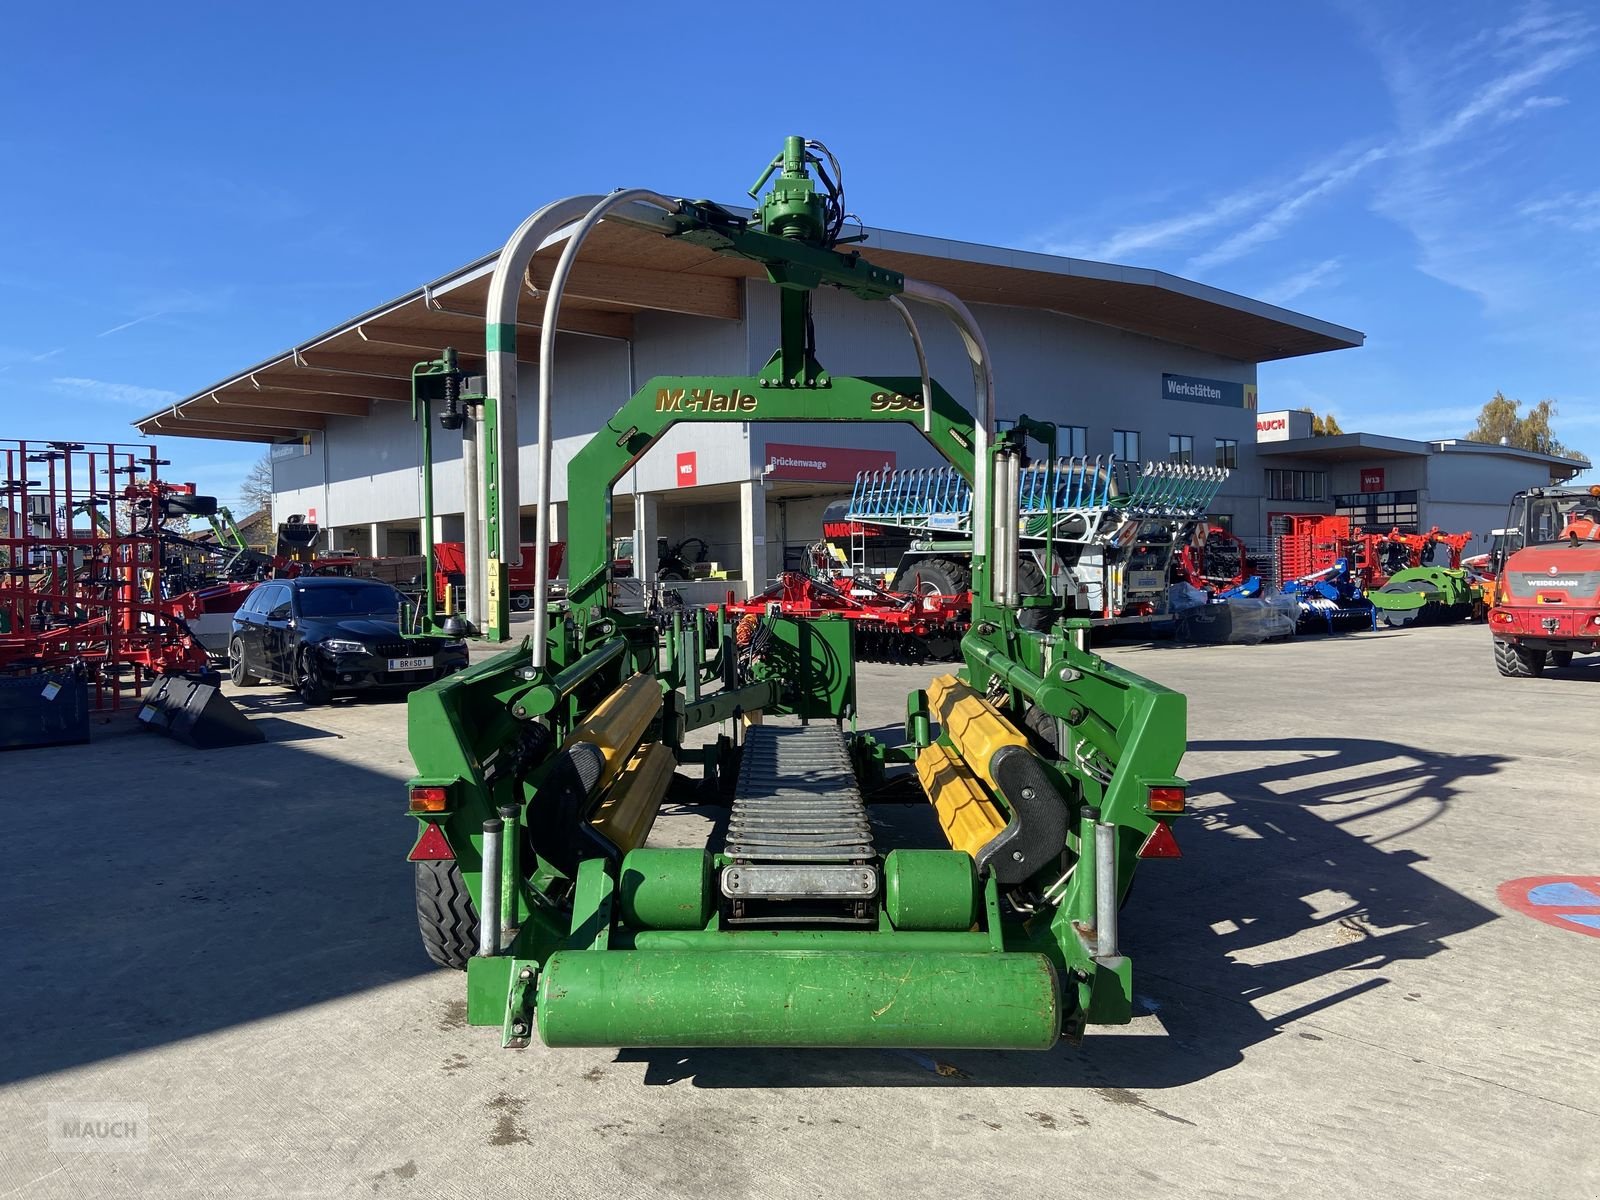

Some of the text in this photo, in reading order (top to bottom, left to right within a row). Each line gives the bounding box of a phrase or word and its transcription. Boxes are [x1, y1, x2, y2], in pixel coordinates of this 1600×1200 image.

[1167, 380, 1221, 399] Werkstätten
[655, 388, 758, 412] McHale
[870, 391, 925, 411] 998
[1256, 419, 1286, 432] AUCH
[770, 456, 827, 470] Brückenwaage
[400, 660, 409, 668] BR
